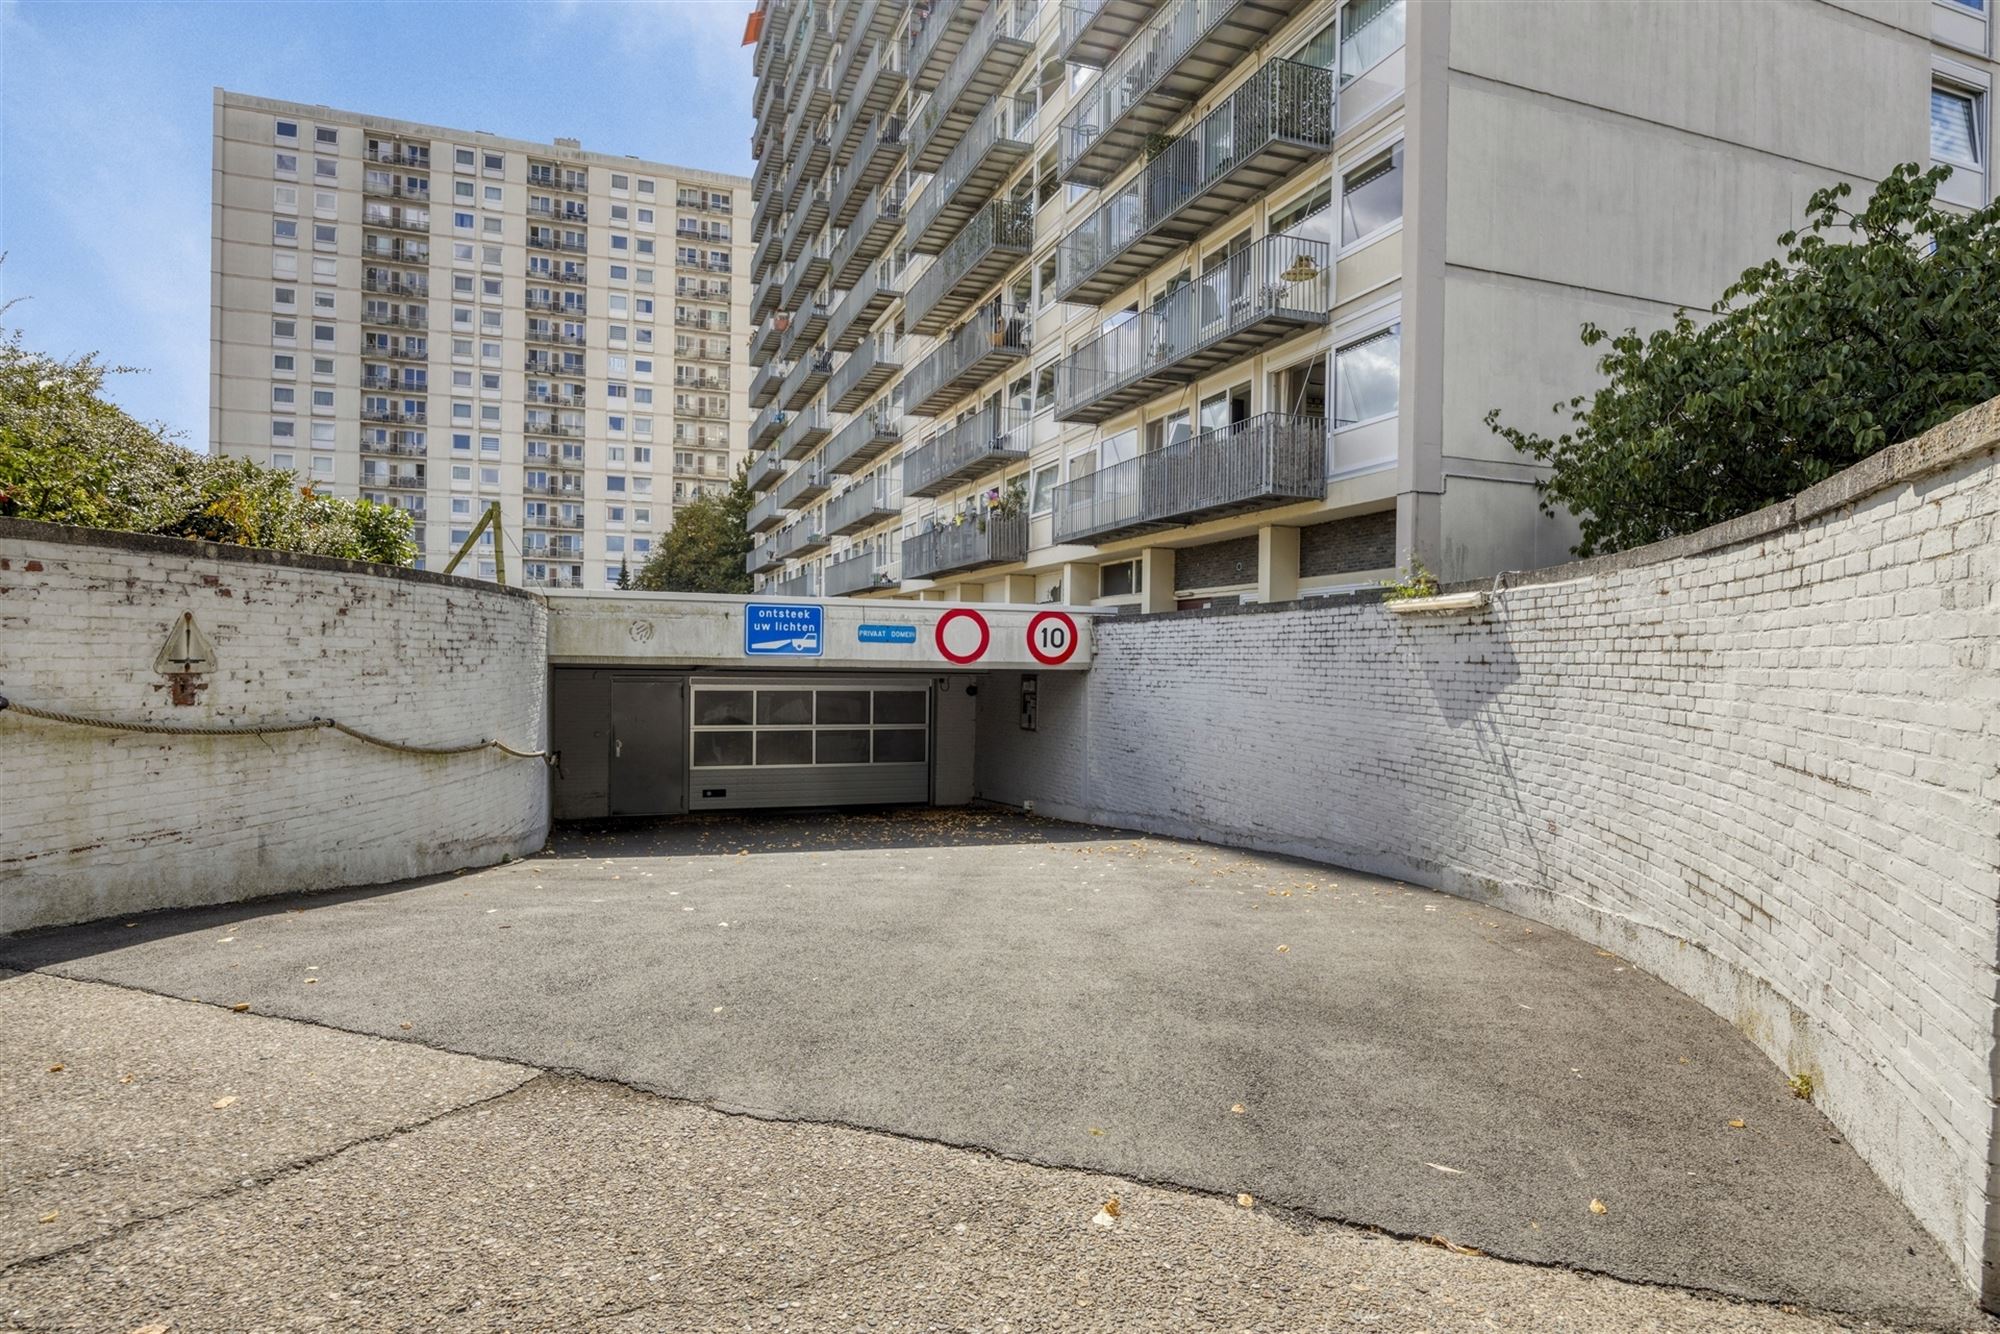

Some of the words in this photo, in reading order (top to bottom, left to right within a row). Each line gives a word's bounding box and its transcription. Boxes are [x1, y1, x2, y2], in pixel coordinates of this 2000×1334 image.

[758, 608, 811, 619] ontsteek
[754, 623, 771, 631] uw
[775, 622, 815, 632] lichten
[891, 630, 916, 638] DOMEIN
[1041, 627, 1065, 648] 10
